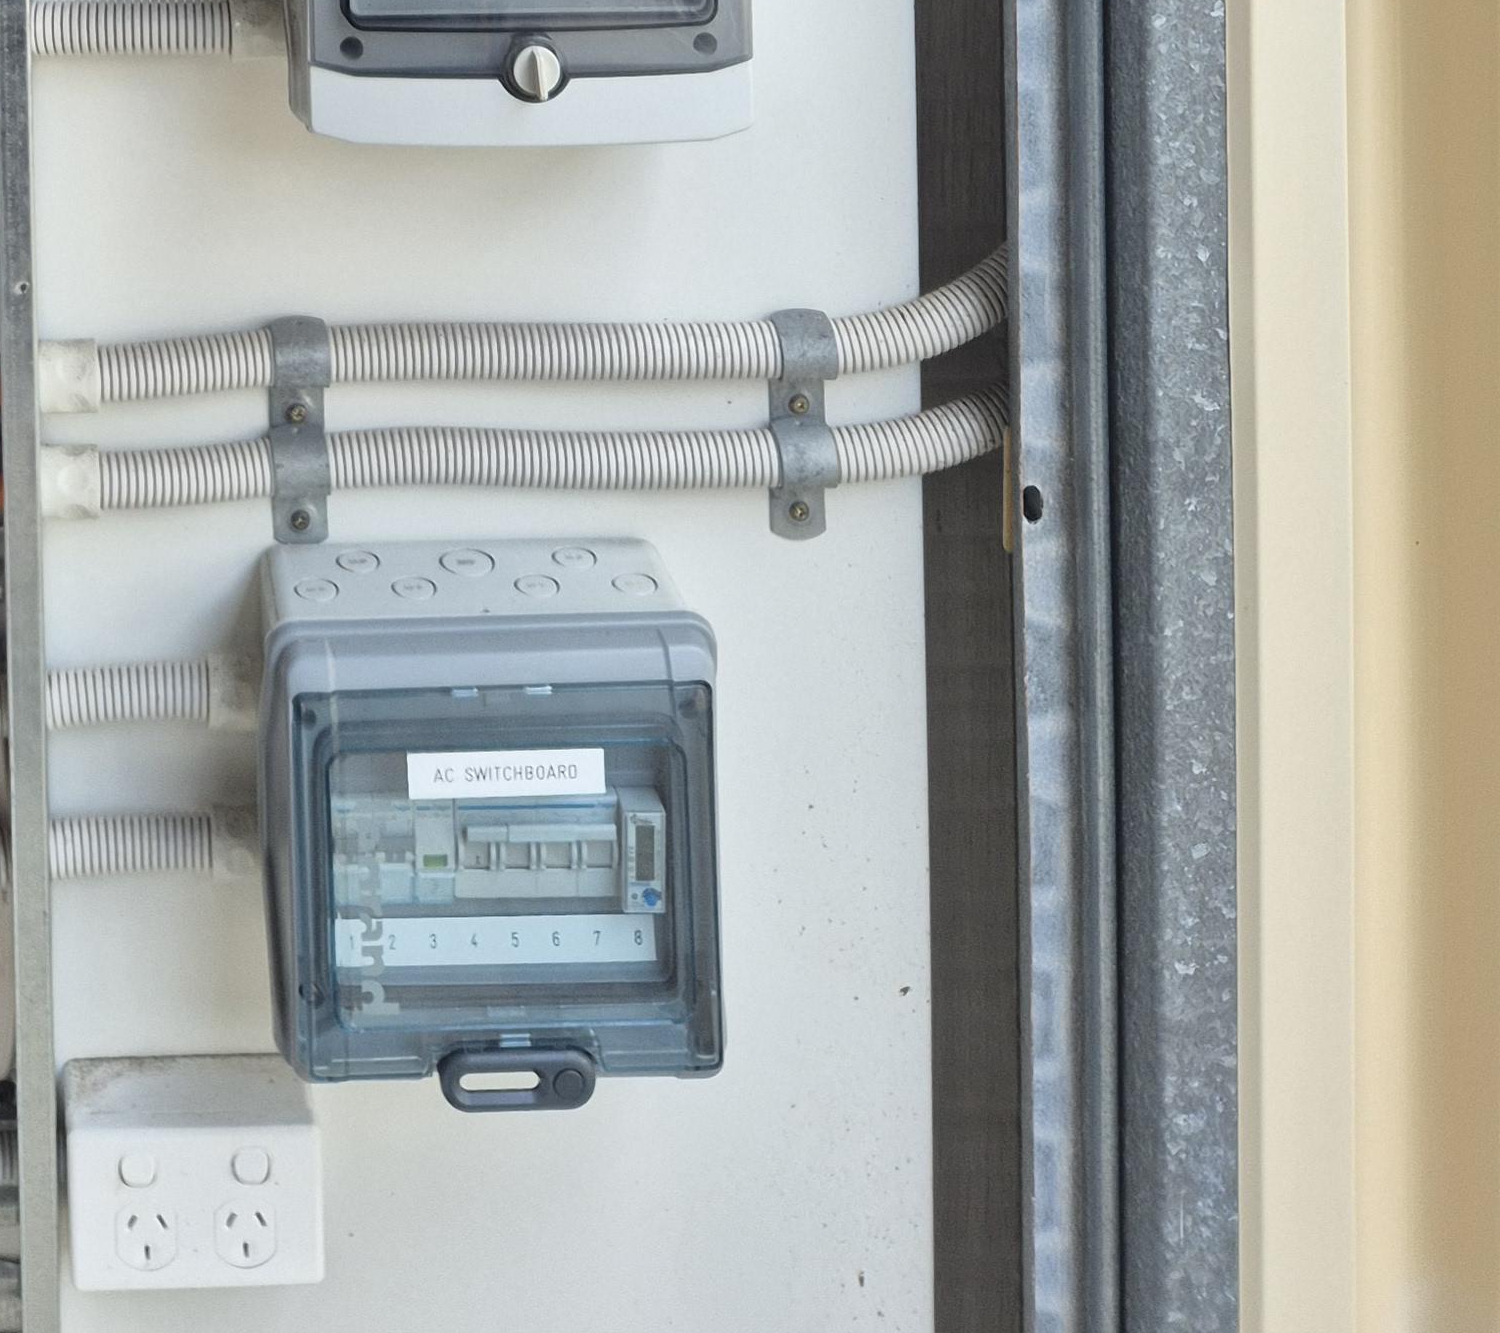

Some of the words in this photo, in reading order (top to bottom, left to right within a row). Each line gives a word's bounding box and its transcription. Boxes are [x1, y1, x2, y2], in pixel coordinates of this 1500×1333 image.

[434, 769, 454, 783] AC
[464, 764, 578, 782] SWITCHBOARD
[388, 935, 396, 950] 2
[429, 934, 437, 948] 3
[471, 933, 479, 947] 4
[511, 932, 519, 947] 5
[552, 932, 560, 946] 6
[593, 930, 601, 945] 7
[634, 930, 643, 945] 8
